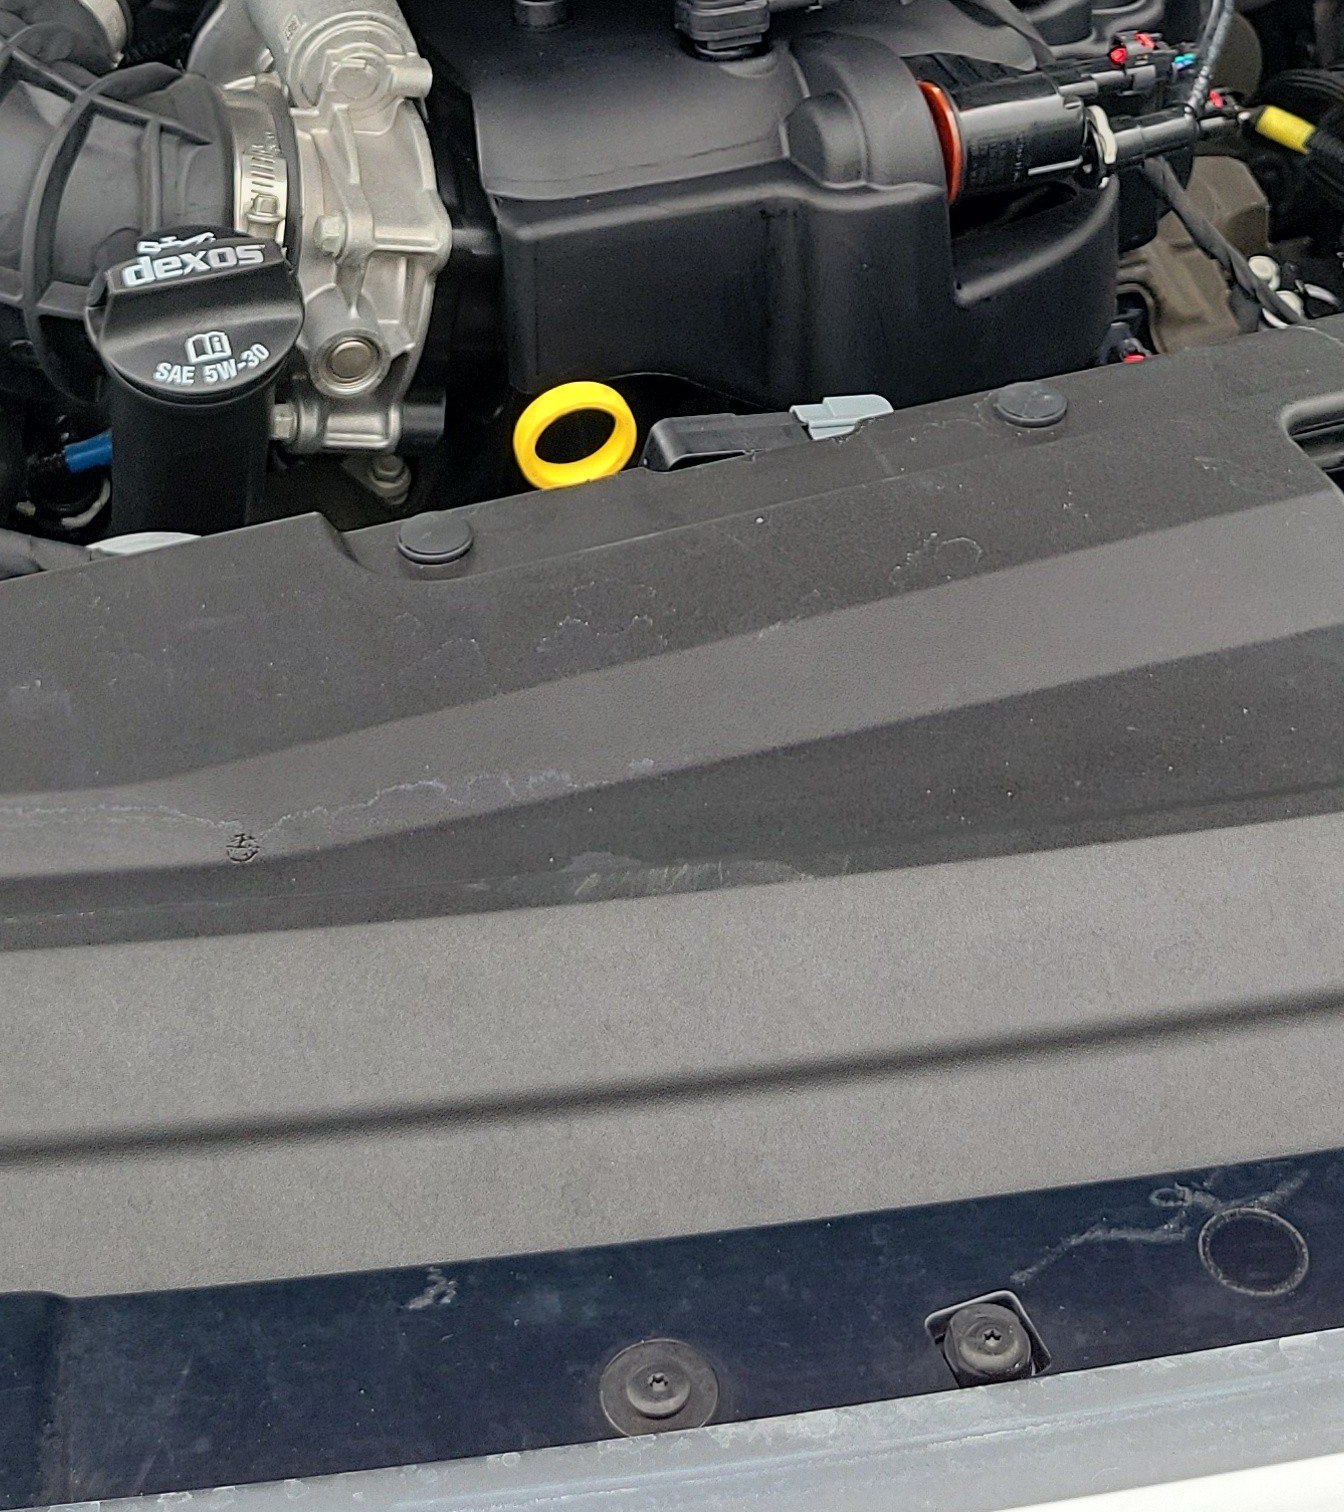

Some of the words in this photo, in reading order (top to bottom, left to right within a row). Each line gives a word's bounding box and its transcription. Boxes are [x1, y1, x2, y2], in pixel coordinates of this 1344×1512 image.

[122, 244, 265, 287] dexos
[153, 362, 196, 385] SAE
[203, 343, 270, 384] 5W-30
